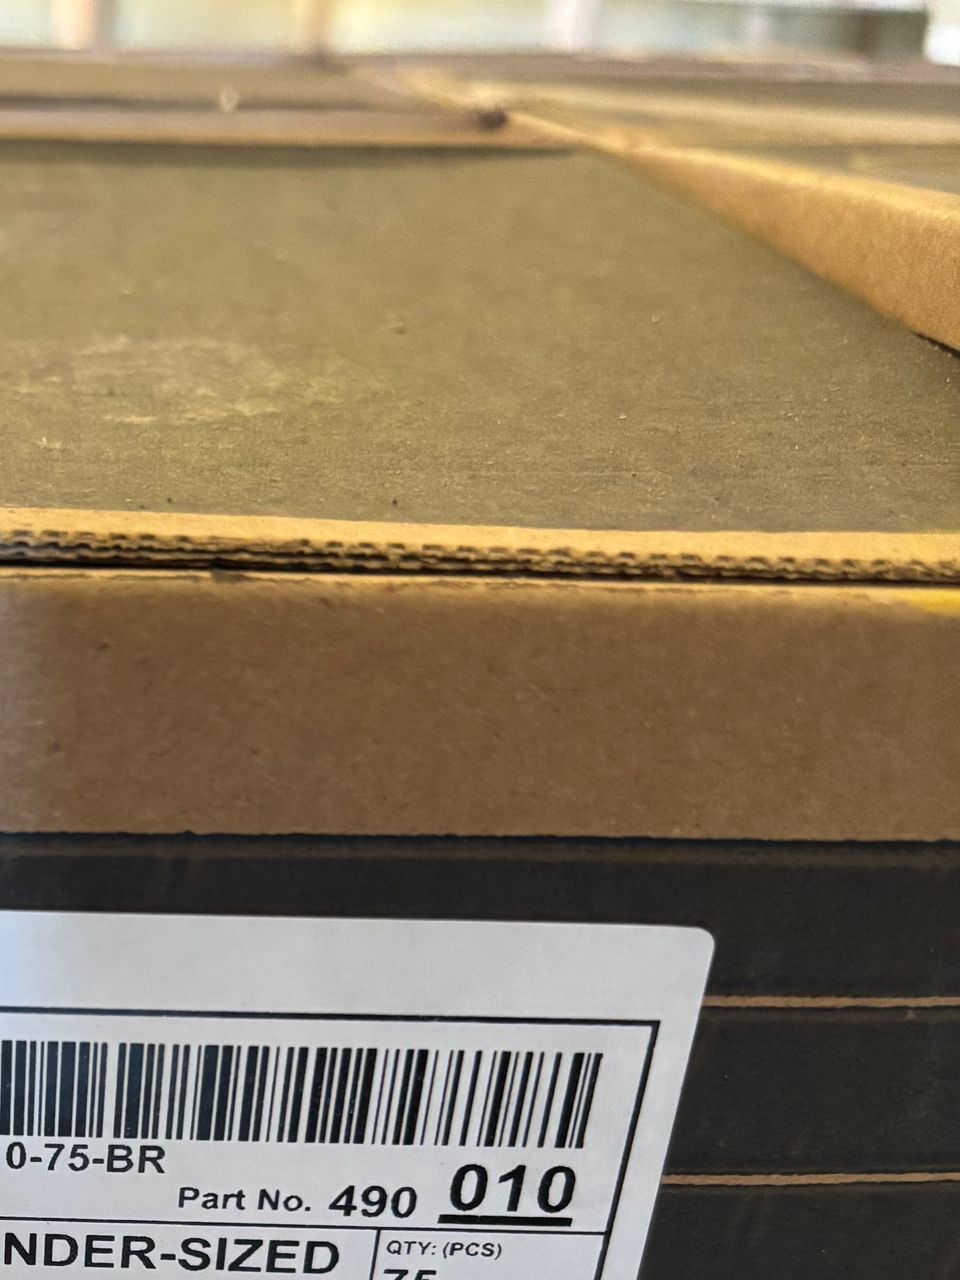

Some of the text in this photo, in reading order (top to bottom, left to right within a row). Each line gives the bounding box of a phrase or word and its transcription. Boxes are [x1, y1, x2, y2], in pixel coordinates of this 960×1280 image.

[178, 1163, 577, 1219] Part No. 490 010
[386, 1240, 503, 1260] QTY: (PCS)
